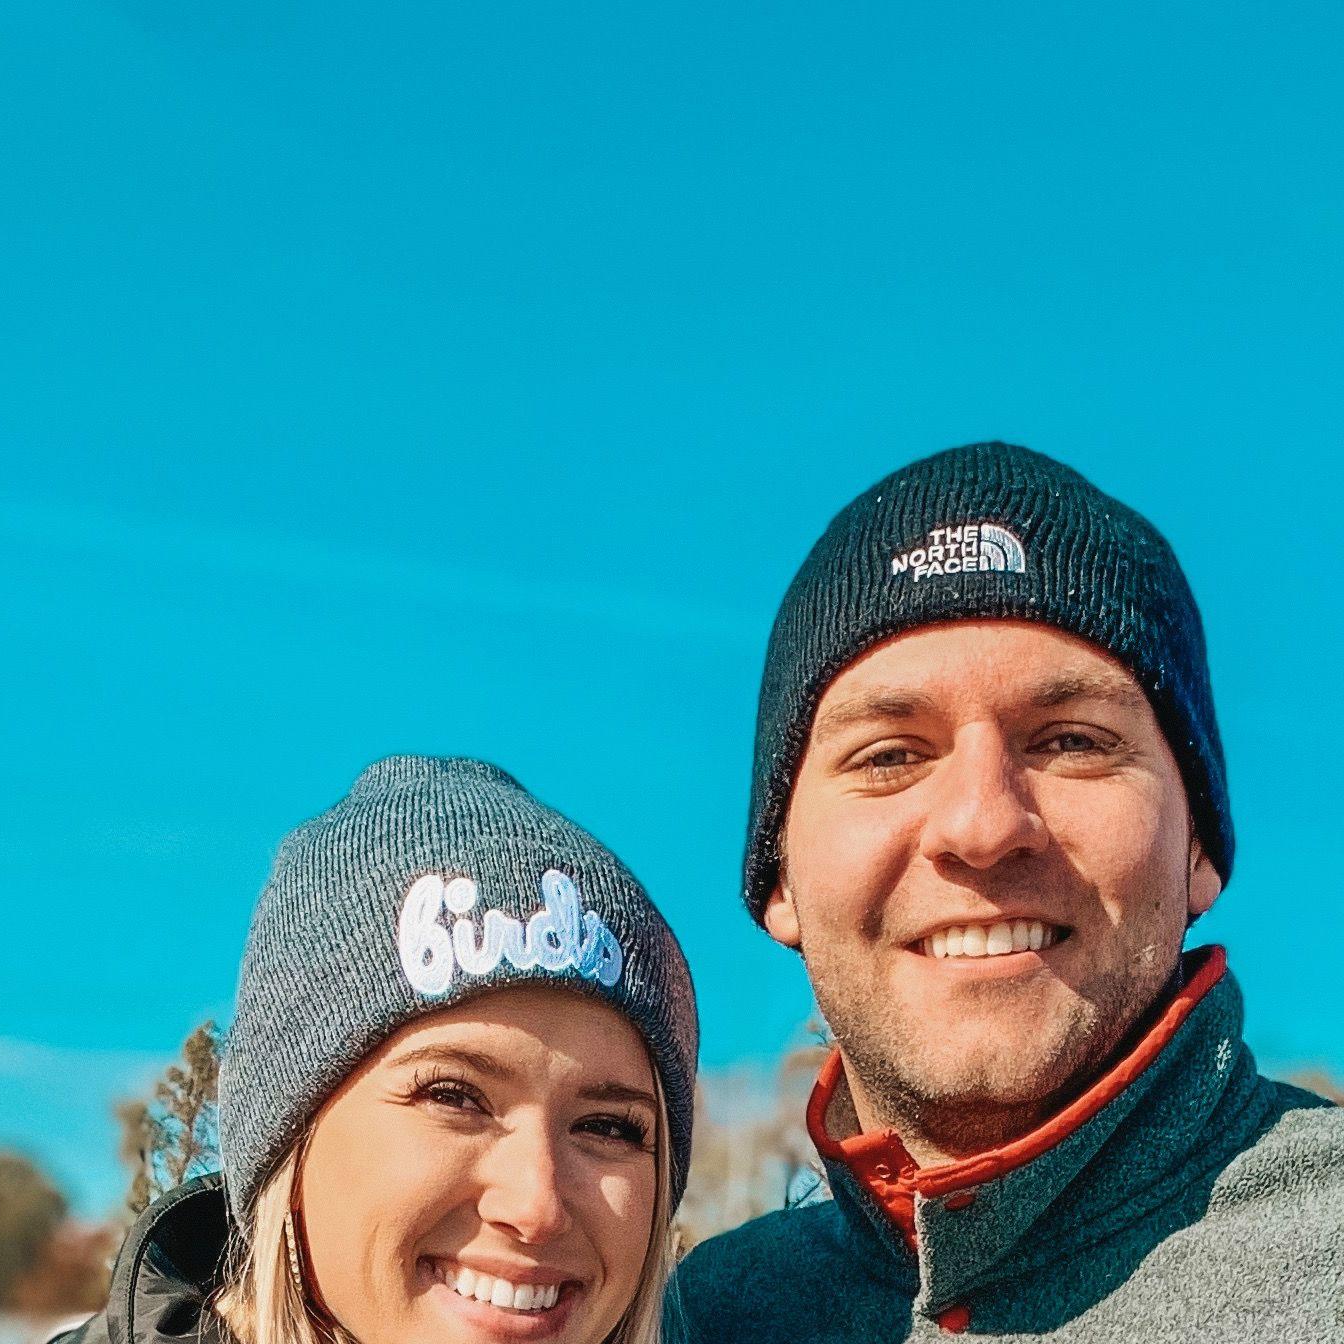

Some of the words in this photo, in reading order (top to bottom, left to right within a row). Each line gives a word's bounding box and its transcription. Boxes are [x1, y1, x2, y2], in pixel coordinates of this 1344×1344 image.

[929, 525, 978, 546] THE
[891, 539, 978, 576] NORTH
[913, 556, 979, 583] FACE
